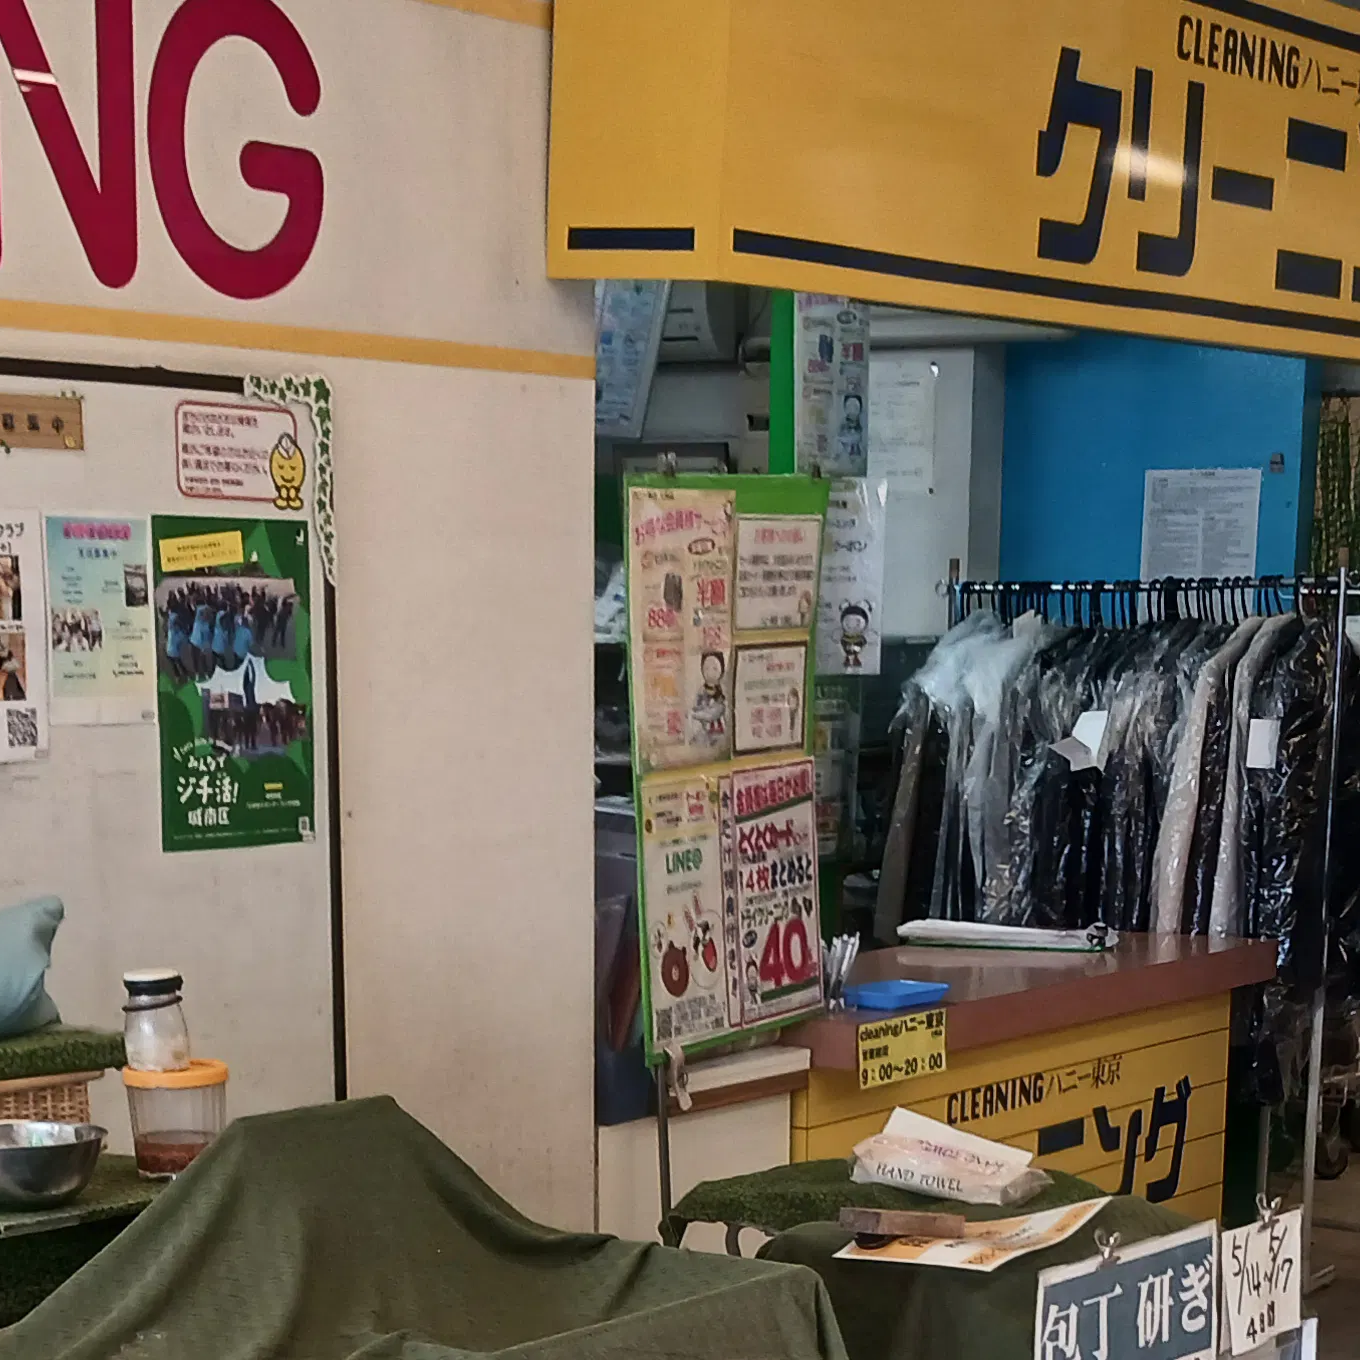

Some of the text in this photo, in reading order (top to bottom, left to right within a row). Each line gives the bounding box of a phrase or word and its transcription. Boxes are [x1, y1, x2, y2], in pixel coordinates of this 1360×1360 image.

[1176, 14, 1301, 89] CLEANING
[946, 1071, 1044, 1125] CLEANING
[876, 1162, 964, 1194] HAND TOWEL
